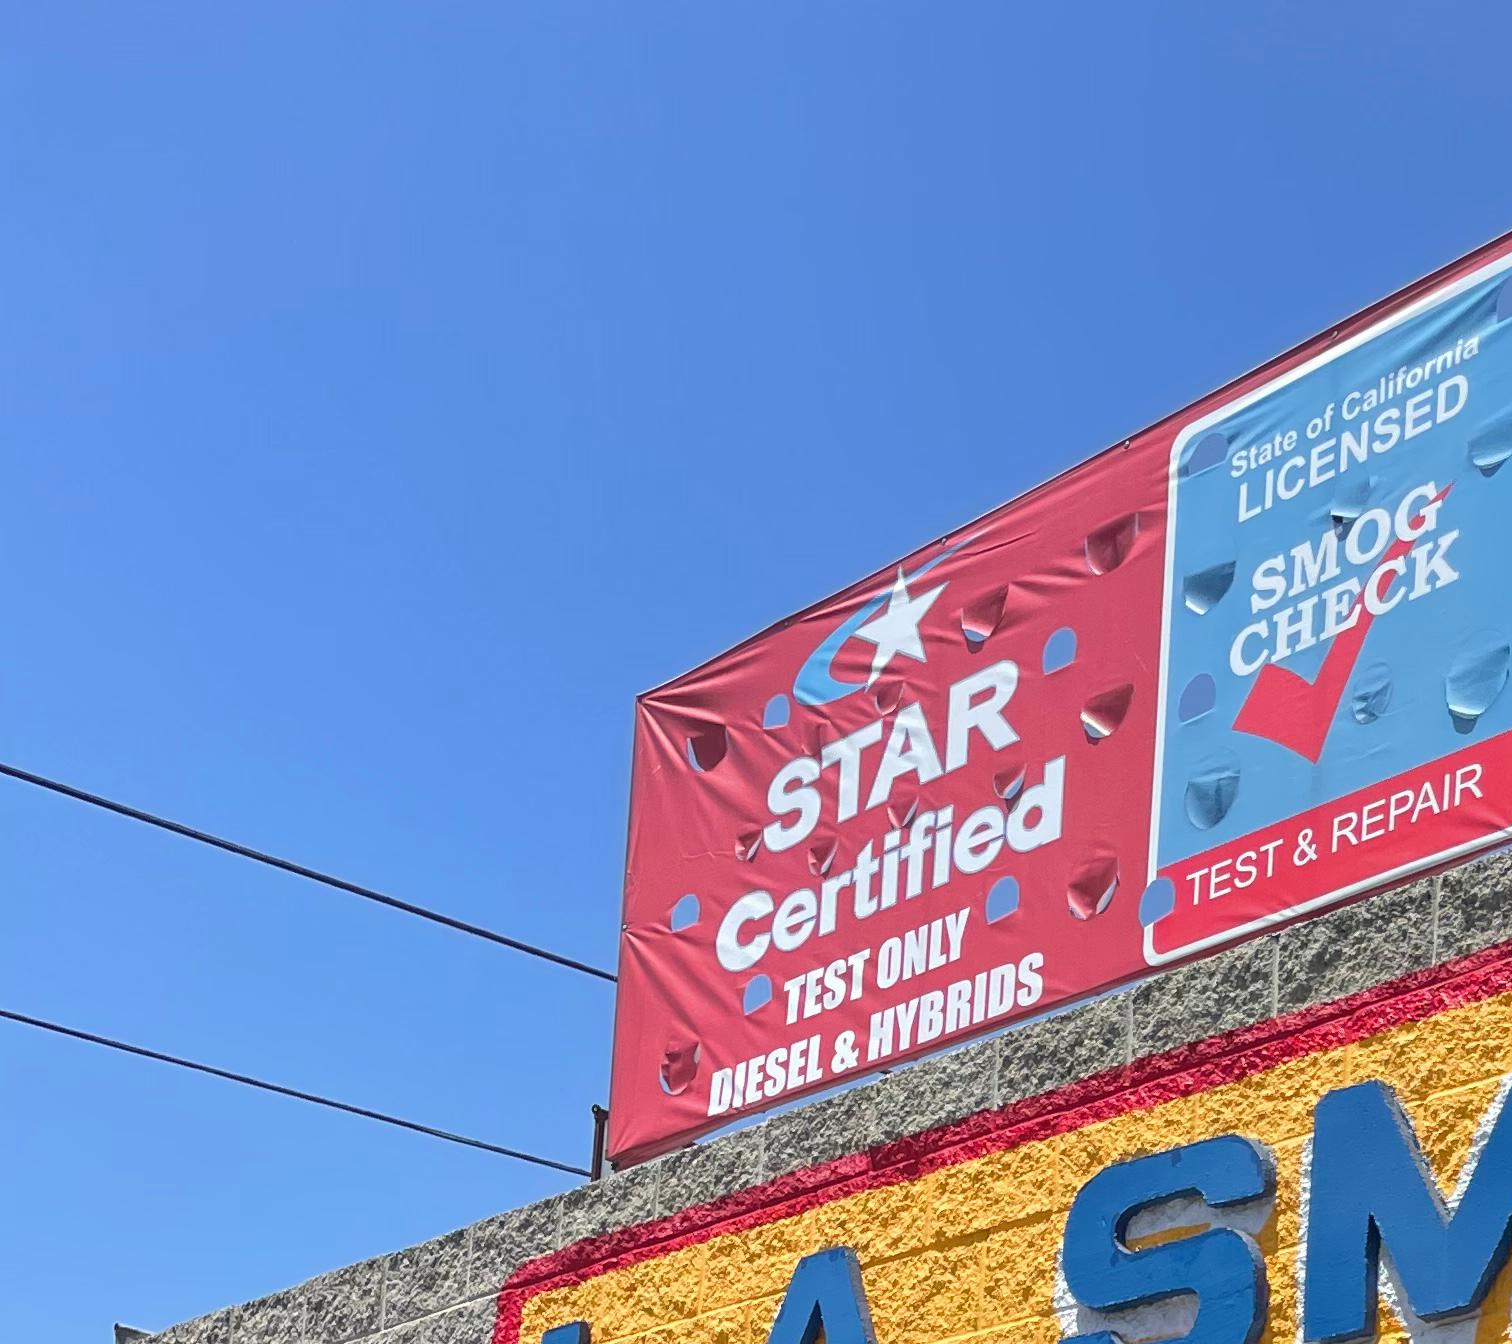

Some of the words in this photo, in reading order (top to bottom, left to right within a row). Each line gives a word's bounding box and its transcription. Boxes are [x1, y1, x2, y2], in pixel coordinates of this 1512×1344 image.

[1230, 431, 1297, 478] State
[1306, 403, 1335, 440] of
[1341, 335, 1481, 420] California
[1237, 374, 1469, 523] LICENSED
[1229, 529, 1461, 677] CHECK
[1250, 480, 1444, 615] SMOG
[762, 660, 1020, 853] STAR
[715, 755, 1066, 972] Certified
[1186, 840, 1284, 907] TEST
[1292, 827, 1319, 864] &
[1332, 761, 1486, 852] REPAIR
[708, 1052, 825, 1117] DIESEL
[832, 1031, 860, 1074] &
[868, 953, 1044, 1062] HYBRIDS
[783, 949, 870, 1025] TEST
[877, 908, 971, 988] ONLY
